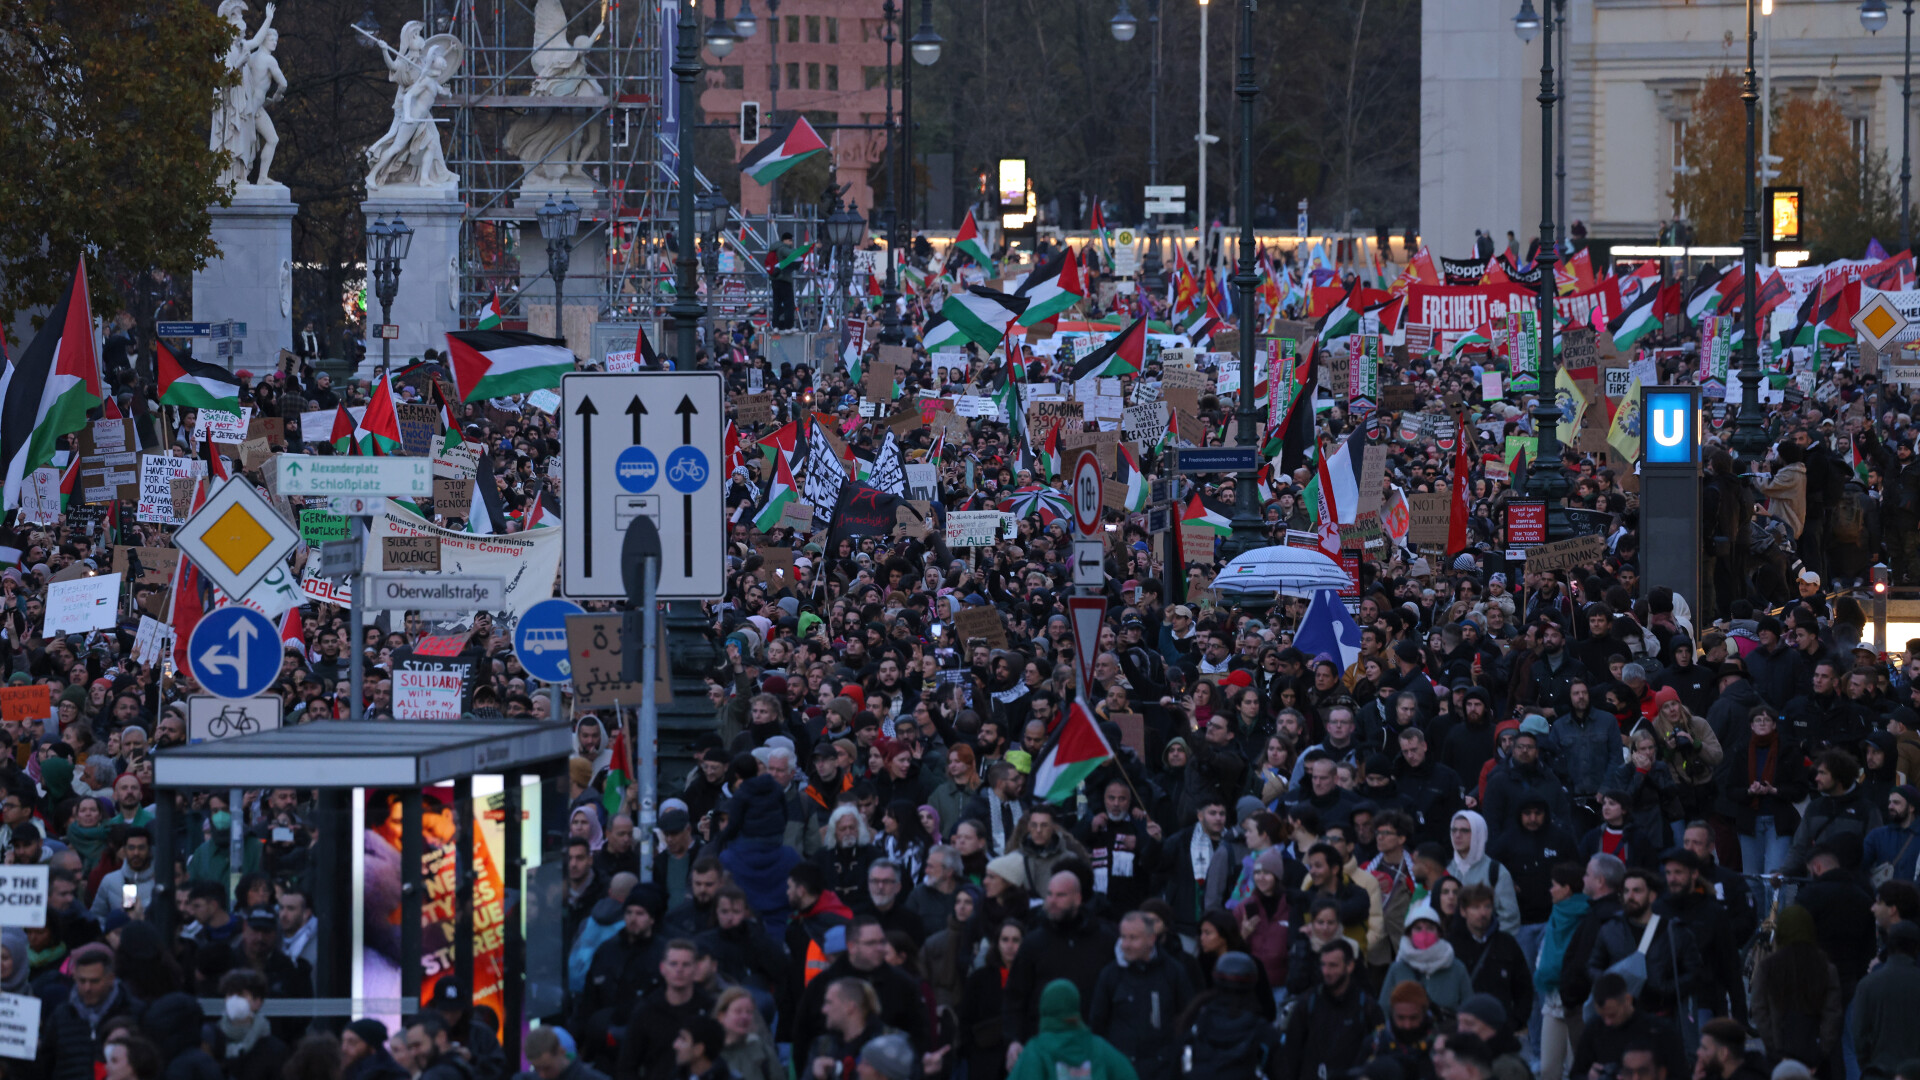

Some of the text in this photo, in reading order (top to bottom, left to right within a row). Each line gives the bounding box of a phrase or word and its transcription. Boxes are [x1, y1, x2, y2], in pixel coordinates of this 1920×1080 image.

[1444, 262, 1485, 278] Stoppt
[1825, 267, 1838, 281] THE
[1422, 294, 1488, 332] FREIHEIT
[1490, 300, 1507, 318] FÜR
[1075, 338, 1088, 347] NO
[1509, 314, 1518, 372] QUEERS FOR
[1518, 334, 1526, 360] FREE
[1526, 313, 1536, 372] PALESTINE
[1718, 318, 1730, 379] PALESTINE
[608, 352, 636, 362] Never
[1164, 352, 1183, 360] BERLIN
[1564, 346, 1594, 358] GENOZID
[1712, 340, 1720, 365] FREE
[1332, 360, 1350, 371] NO
[1350, 336, 1362, 396] QUEERS FOR
[1368, 336, 1377, 397] PALESTINE
[1575, 358, 1597, 367] GAZA
[1606, 371, 1630, 383] CEASE
[1038, 402, 1084, 418] BOMBING
[1127, 402, 1162, 414] HUNDREDS
[97, 420, 121, 428] NICHT
[204, 413, 236, 423] BABIES
[1136, 414, 1158, 422] UNDER
[1136, 420, 1160, 428] RUBBLE
[215, 422, 230, 430] NOT
[1654, 410, 1684, 446] U
[195, 429, 213, 440] SEF
[146, 457, 183, 467] LAND YOU
[146, 466, 189, 478] HAVE TO KILL
[310, 462, 378, 476] Alexanderplatz
[144, 476, 160, 484] FOR
[310, 478, 382, 492] Schloßplatz
[444, 481, 466, 490] STOP
[143, 495, 156, 504] YOU
[1080, 477, 1096, 512] 18t
[140, 504, 172, 514] DIE FOR
[1412, 500, 1434, 510] NOT
[35, 511, 52, 520] NOW
[302, 512, 342, 524] GERMANS
[384, 512, 416, 529] Alliance
[428, 526, 492, 544] Internationalist
[493, 536, 534, 548] Feminists
[306, 538, 320, 548] THE
[388, 538, 432, 548] SILENCE IS
[390, 523, 408, 534] Our
[466, 541, 475, 550] is
[478, 542, 524, 557] Coming!
[966, 536, 992, 546] ALLE
[1526, 538, 1596, 558] EQUAL RIGHTS FOR
[389, 550, 437, 564] VIOLENCE
[388, 584, 488, 602] Oberwallstraße
[403, 660, 472, 678] STOP THE
[401, 674, 463, 697] SOLIDARITY
[12, 704, 40, 714] NOW
[398, 700, 418, 708] ALL
[12, 876, 38, 888] THE
